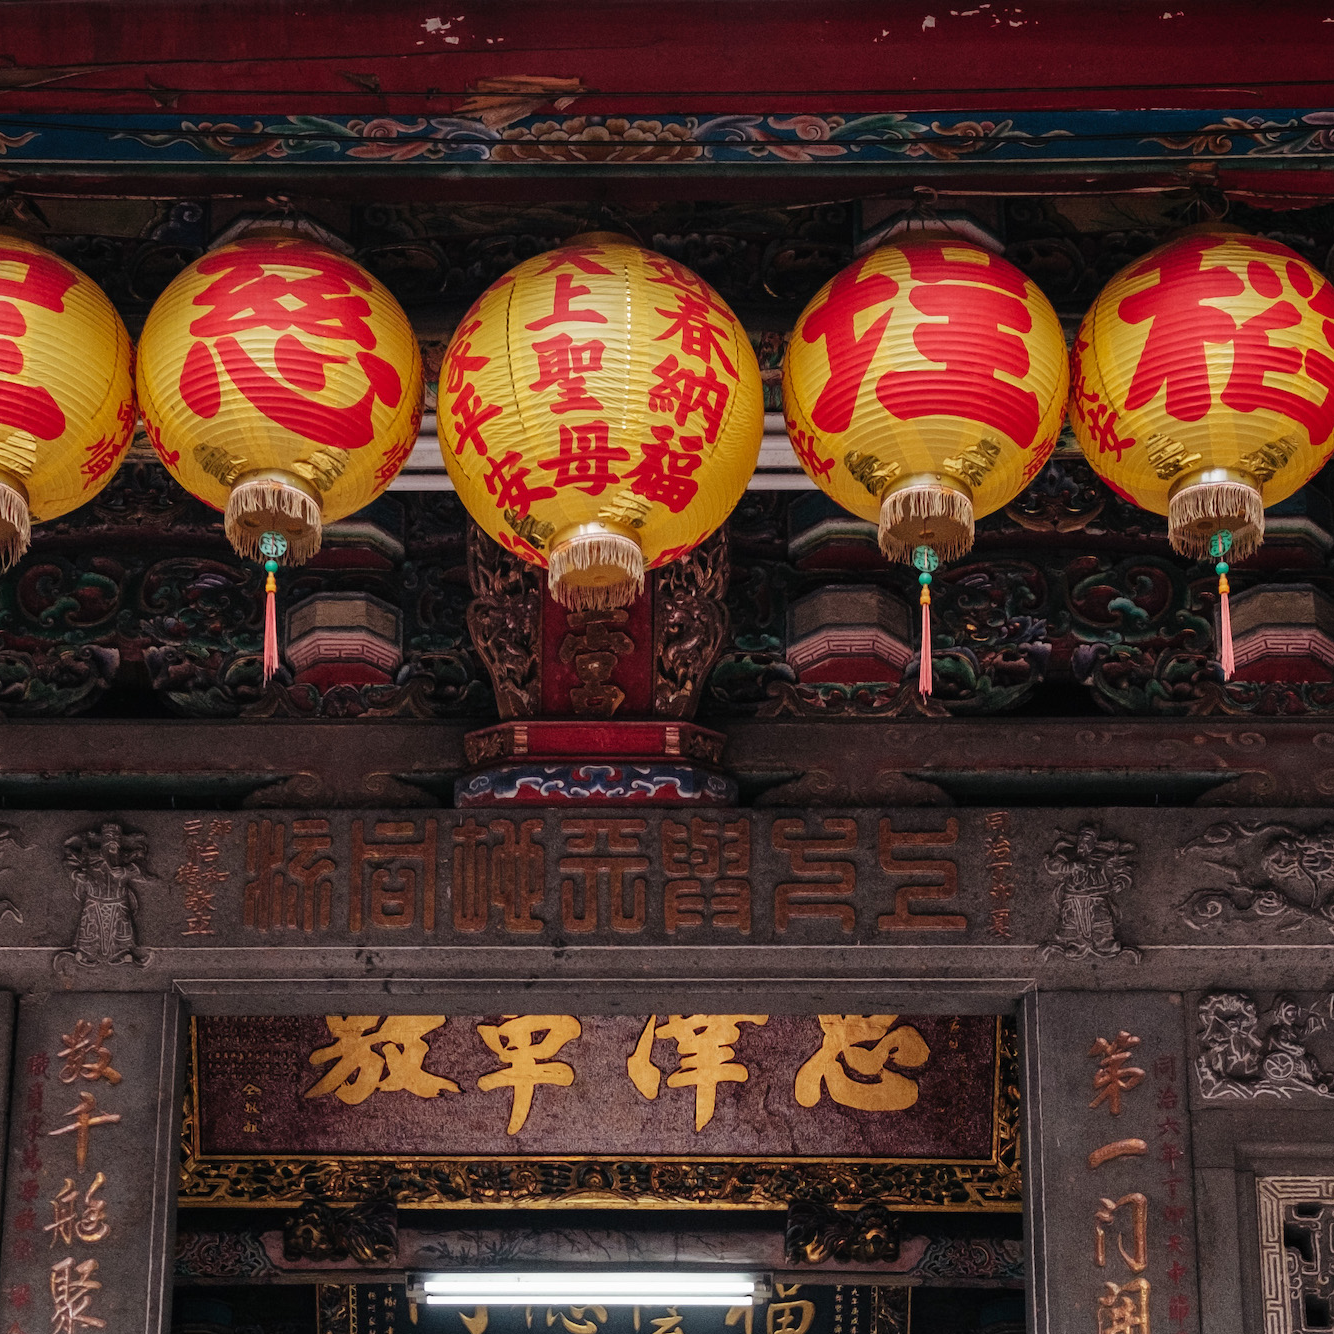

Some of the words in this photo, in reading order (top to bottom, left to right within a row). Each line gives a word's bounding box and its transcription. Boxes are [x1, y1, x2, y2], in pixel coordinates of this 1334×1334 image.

[180, 239, 403, 450] 慈
[439, 276, 557, 520] 家平安
[525, 246, 631, 496] 天上聖母
[557, 610, 637, 718] 宮
